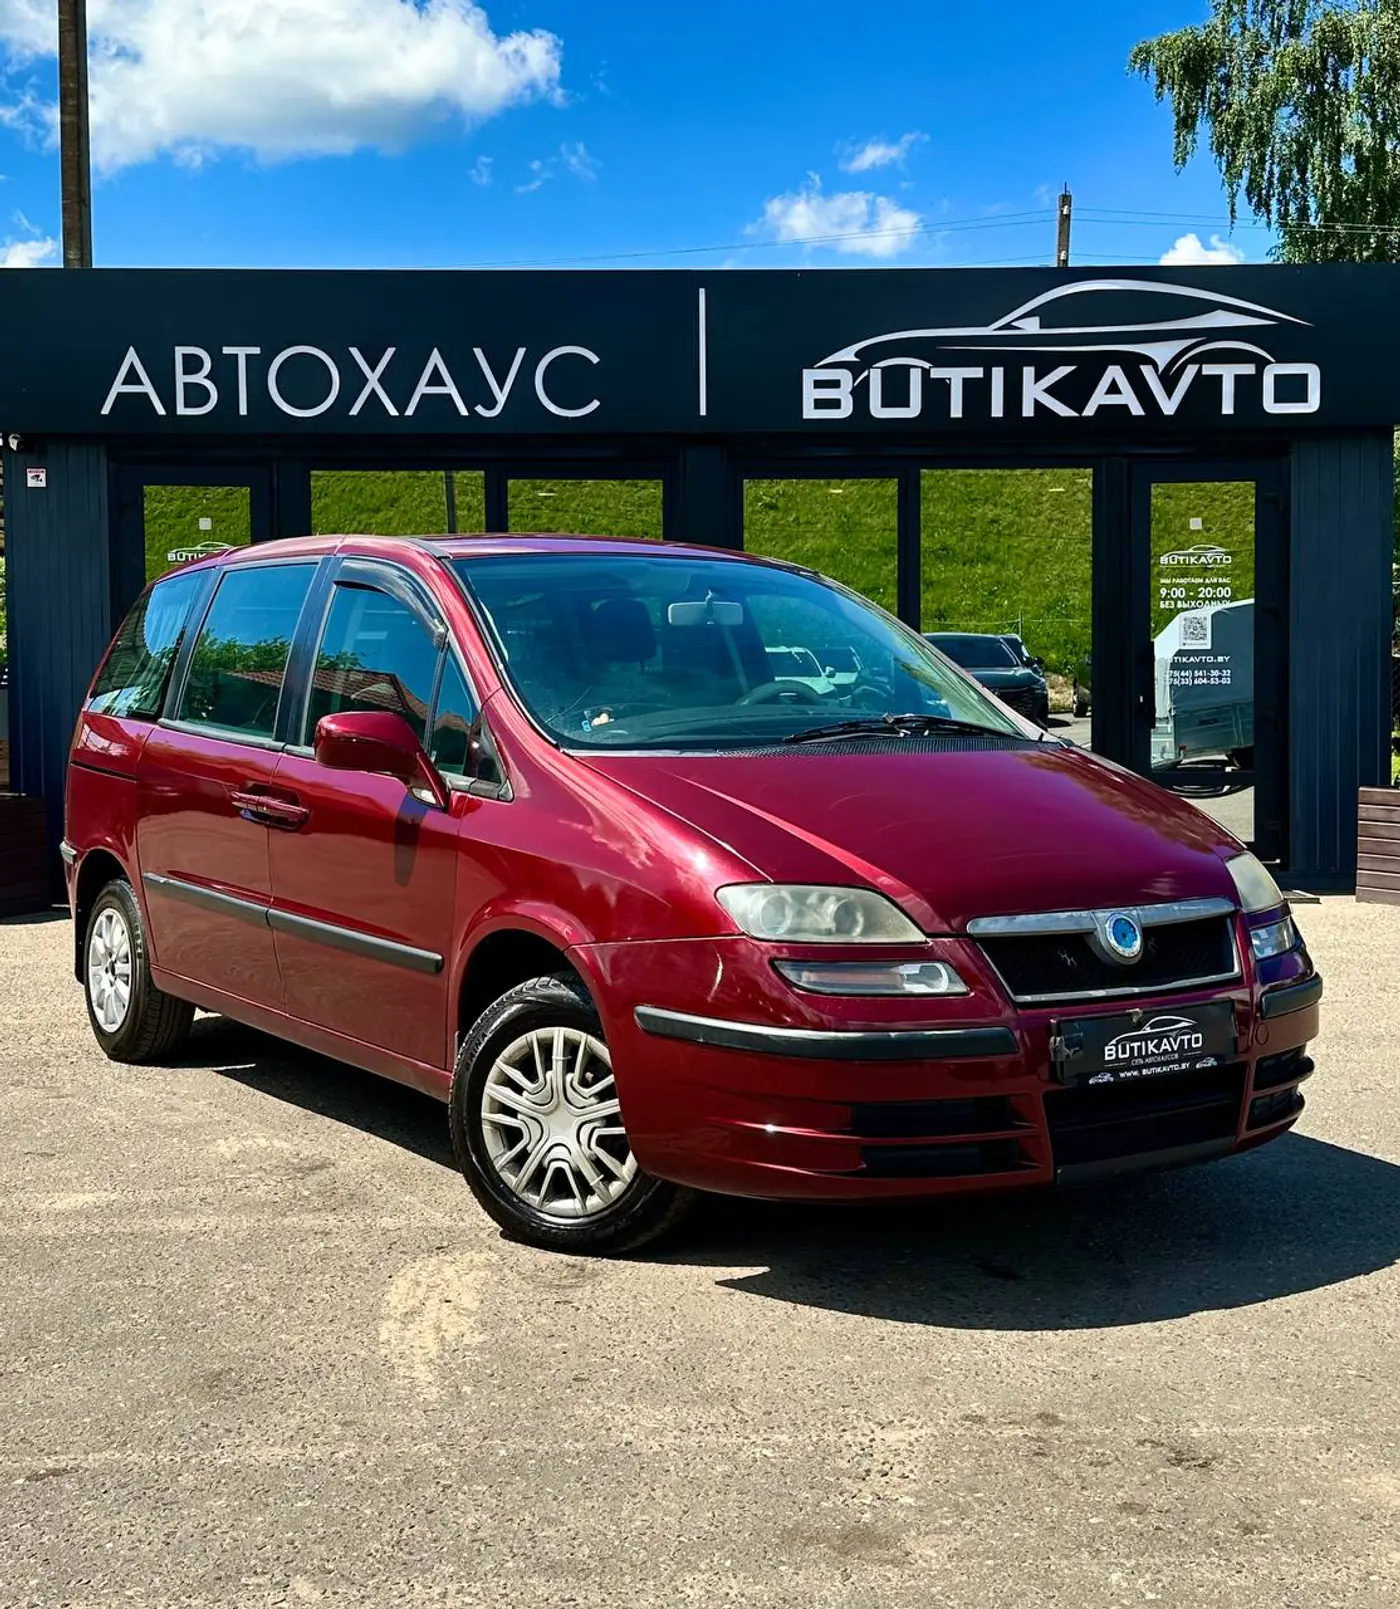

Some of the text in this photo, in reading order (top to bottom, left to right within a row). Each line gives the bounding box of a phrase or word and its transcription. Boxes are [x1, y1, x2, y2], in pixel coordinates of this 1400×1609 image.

[101, 345, 601, 418] АВТОХАУС
[802, 362, 1321, 420] BUTIKAVTO
[1160, 555, 1232, 564] BUTIKAVTO
[1160, 587, 1186, 599] 9:00
[1197, 587, 1232, 598] 20:00
[1160, 601, 1175, 609] БЕЗ
[1194, 669, 1232, 677] 541-30-32
[1104, 1033, 1203, 1060] BUTIKAVTO
[1141, 1062, 1191, 1076] BUTIKAVTO.BY
